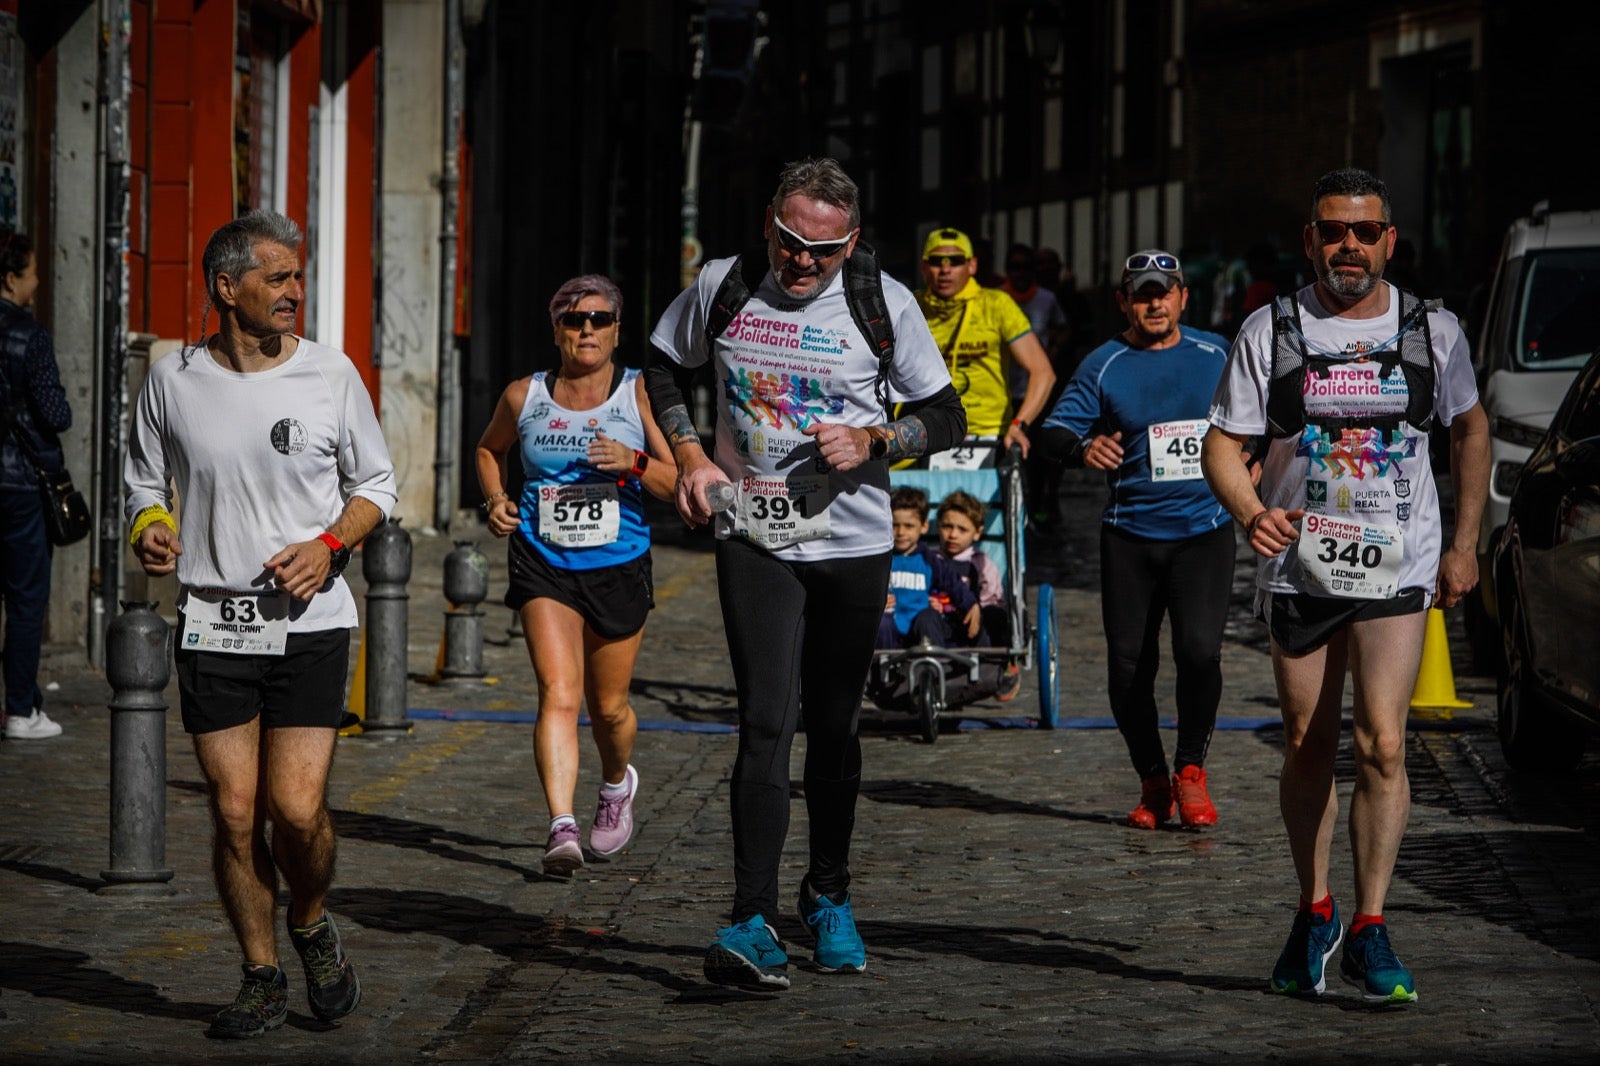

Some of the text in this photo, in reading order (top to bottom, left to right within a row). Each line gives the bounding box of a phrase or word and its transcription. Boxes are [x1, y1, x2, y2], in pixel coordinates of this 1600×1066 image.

[727, 312, 798, 338] 9 Carrera
[803, 325, 822, 335] Ave
[740, 327, 799, 349] Solidaria
[802, 333, 830, 345] María
[800, 342, 843, 355] Granada
[1345, 341, 1374, 351] Altium
[732, 353, 832, 376] Mirando siempre hacia lo alto
[1312, 381, 1379, 396] Solidaria
[1153, 425, 1163, 439] 9
[1163, 424, 1195, 432] Carrera
[768, 438, 802, 448] PUERTA
[1166, 436, 1206, 457] 46
[743, 476, 751, 493] 9
[751, 477, 785, 488] Carrera
[750, 487, 789, 496] Solidaria
[542, 487, 550, 501] 9
[1355, 490, 1391, 500] PUERTA
[553, 501, 603, 522] 578
[752, 495, 807, 520] 391
[1354, 500, 1380, 508] REAL
[769, 521, 796, 530] ACACIO
[1307, 515, 1361, 533] 9 Carrera
[1318, 526, 1362, 542] Solidaria
[1362, 537, 1393, 546] Granada
[1317, 537, 1383, 569] 340
[890, 571, 926, 590] UMA
[1331, 569, 1366, 580] LECHUGA
[220, 598, 256, 623] 63
[209, 622, 265, 634] "DANDO CAÑA"
